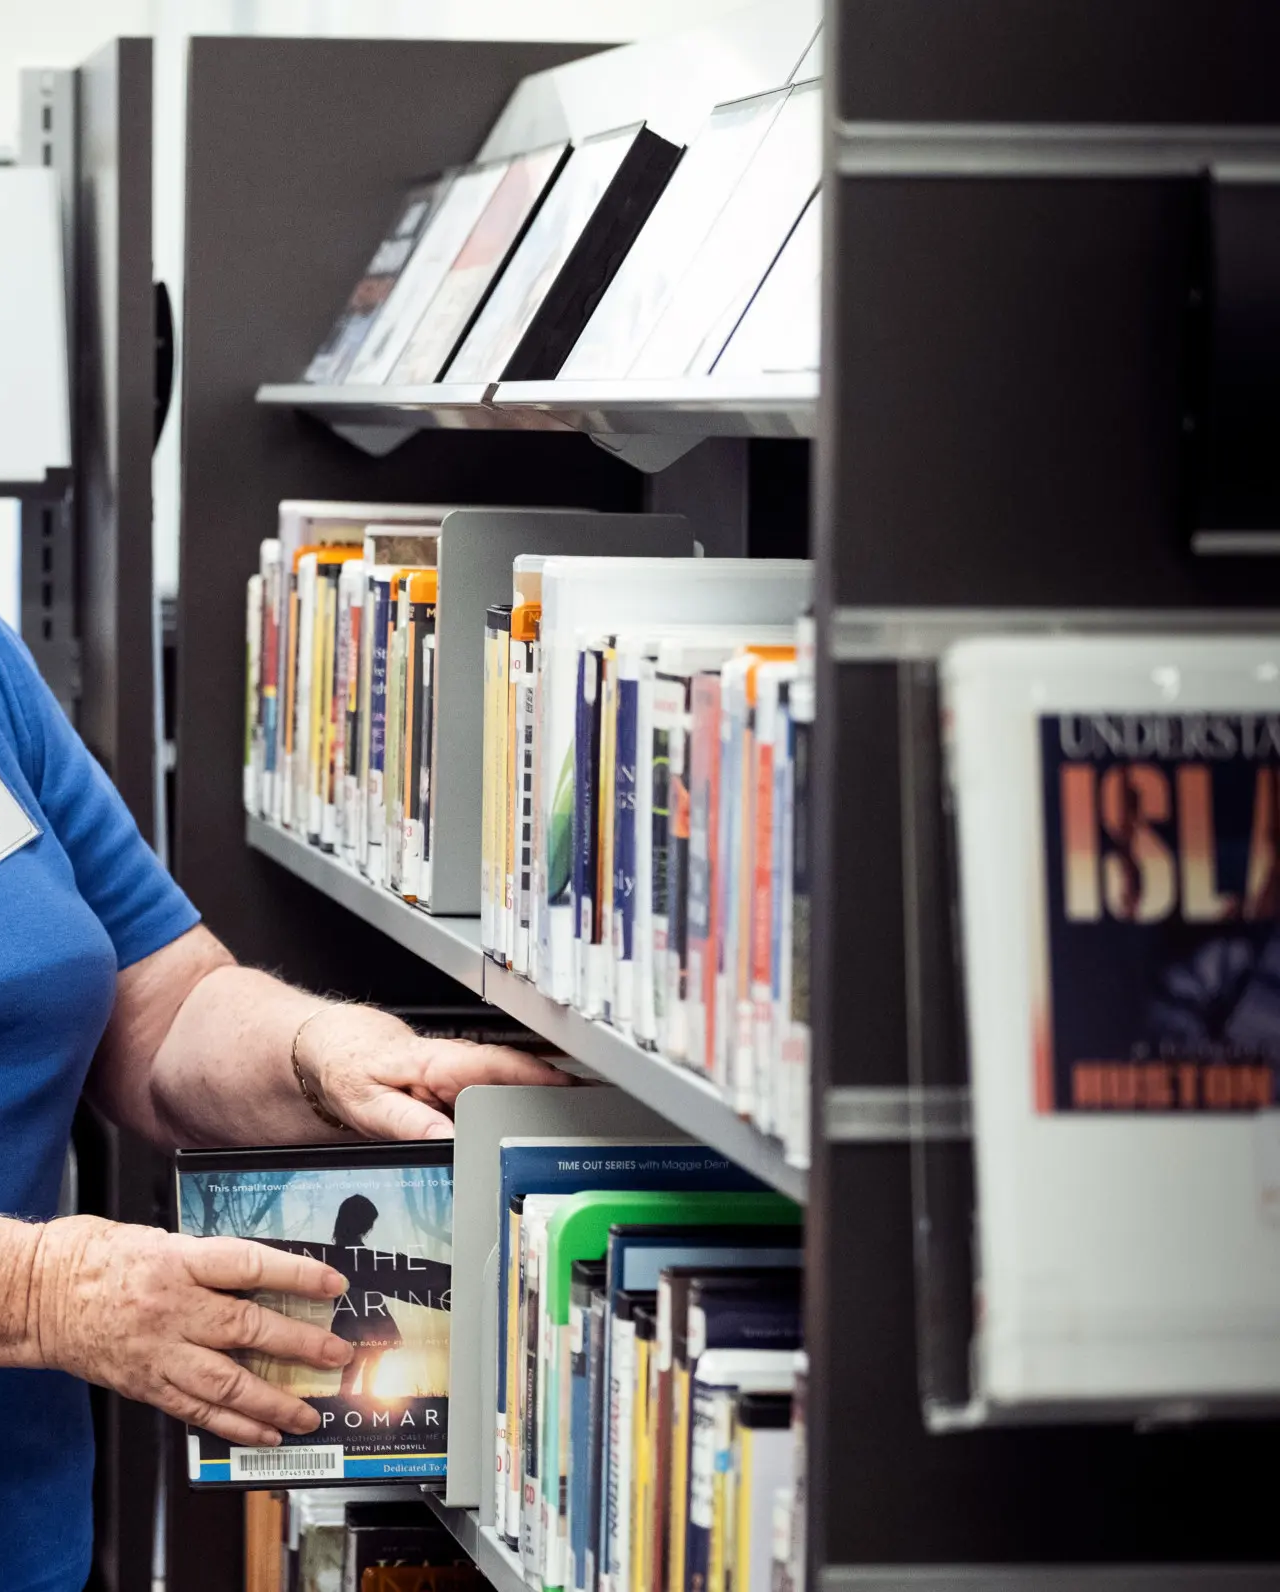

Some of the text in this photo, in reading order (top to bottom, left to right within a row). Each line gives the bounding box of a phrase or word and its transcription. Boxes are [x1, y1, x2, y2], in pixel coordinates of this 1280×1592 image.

[557, 1158, 730, 1173] TIME OUT SERIES with Maggie Dent
[208, 1183, 230, 1193] This
[232, 1183, 260, 1193] small
[427, 1178, 438, 1187] to
[344, 1244, 427, 1272] THE
[346, 1435, 383, 1444] AUTHOR
[394, 1443, 427, 1451] NORVILL
[383, 1462, 427, 1473] Dedicated
[428, 1462, 441, 1473] To
[524, 1484, 535, 1505] CD
